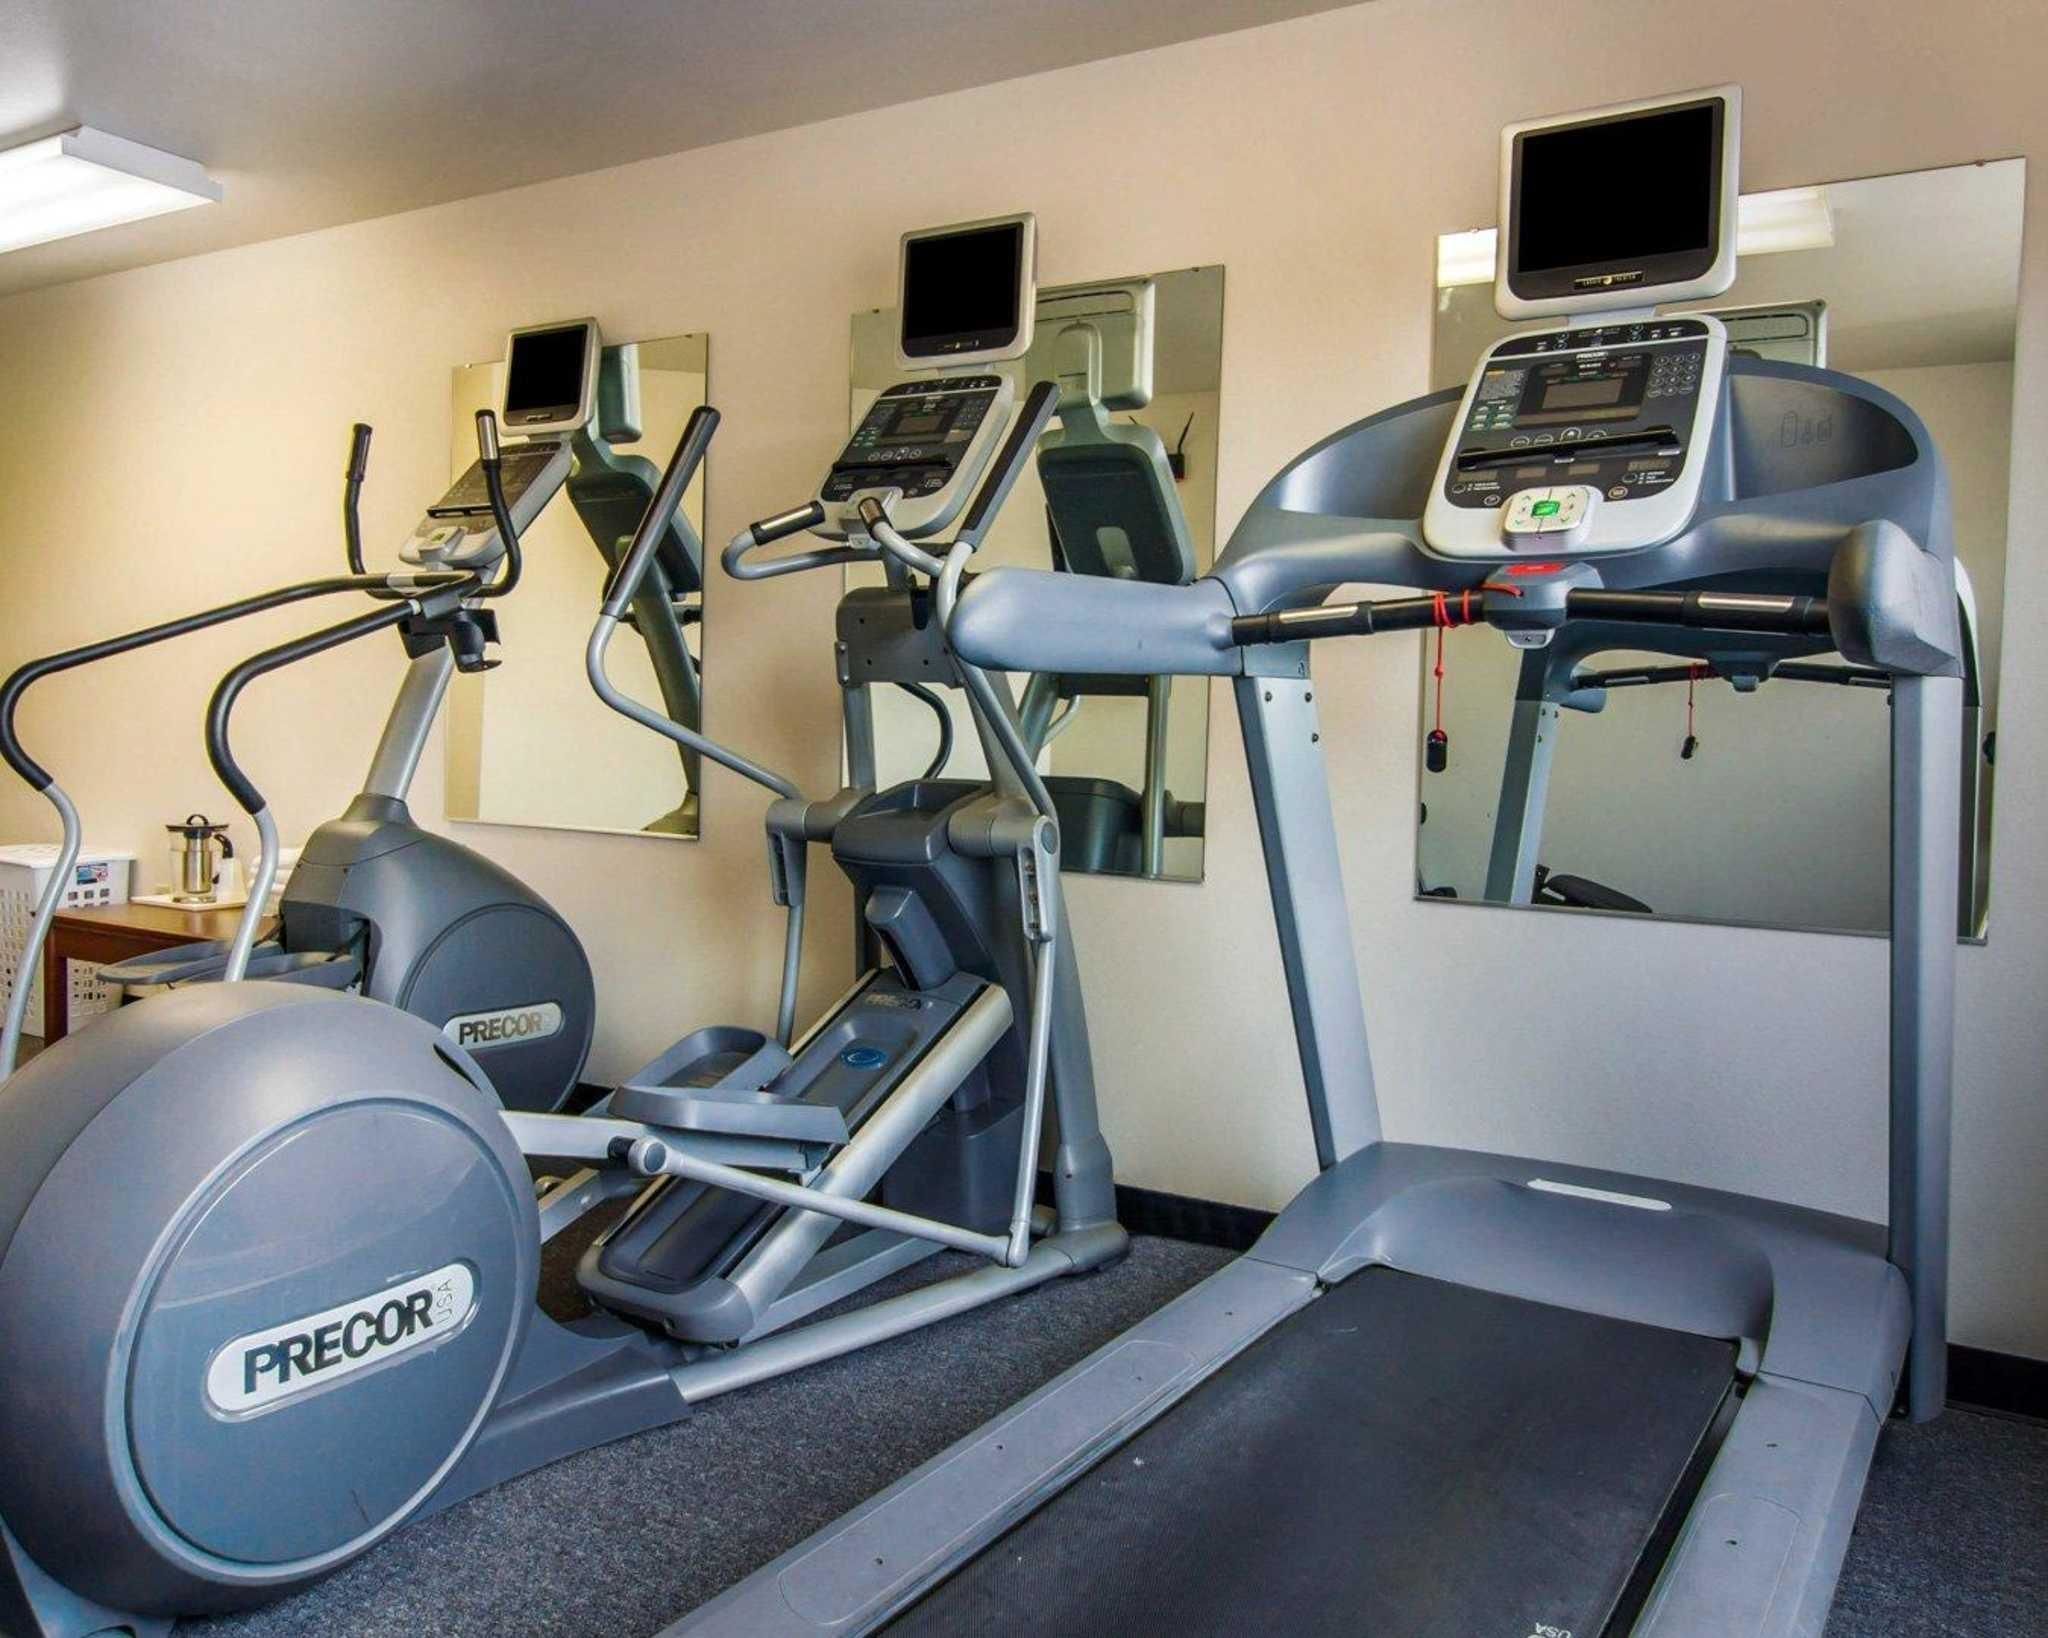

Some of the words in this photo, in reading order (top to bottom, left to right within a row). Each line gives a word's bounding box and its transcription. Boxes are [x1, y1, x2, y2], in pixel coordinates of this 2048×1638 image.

[459, 1012, 542, 1045] PRECOR
[243, 1288, 433, 1395] PRECOR
[437, 1279, 454, 1326] USA
[1536, 1622, 1571, 1638] USA
